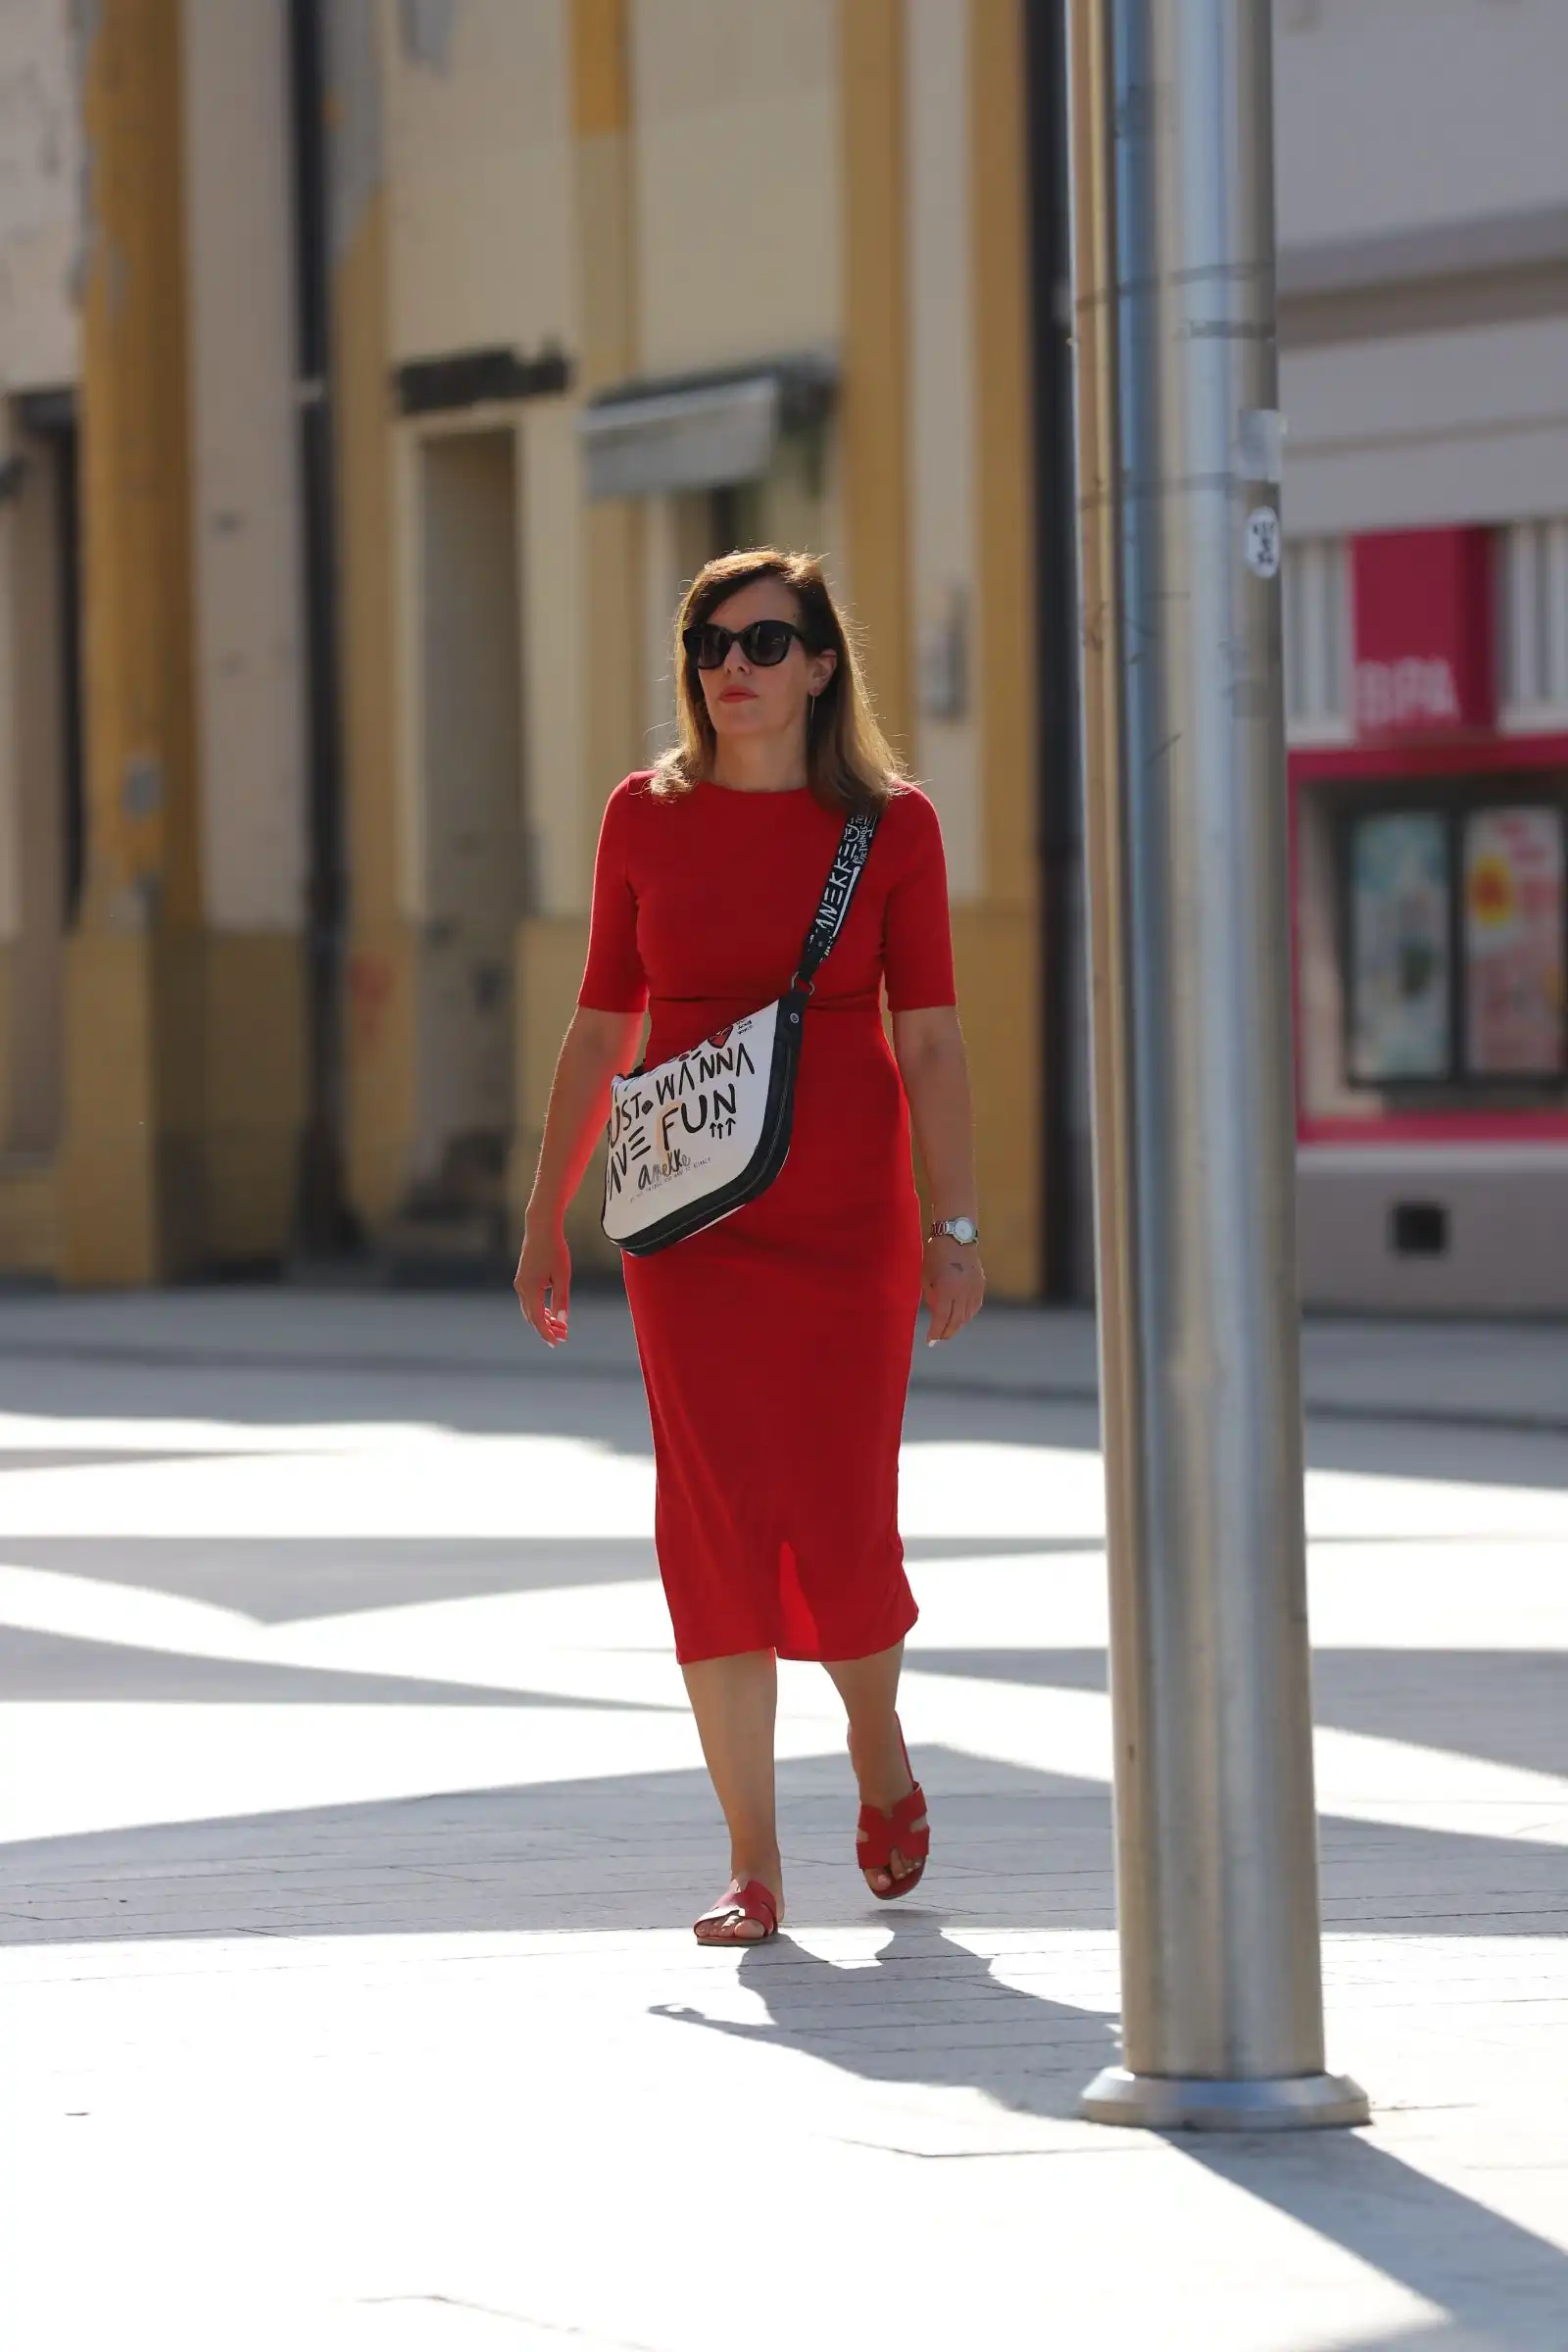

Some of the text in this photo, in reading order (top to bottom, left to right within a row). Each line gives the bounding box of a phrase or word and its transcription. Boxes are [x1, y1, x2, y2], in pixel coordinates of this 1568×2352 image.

[609, 1125, 652, 1201] AVE
[662, 1083, 737, 1152] FUN
[610, 1043, 755, 1150] UST WANNA
